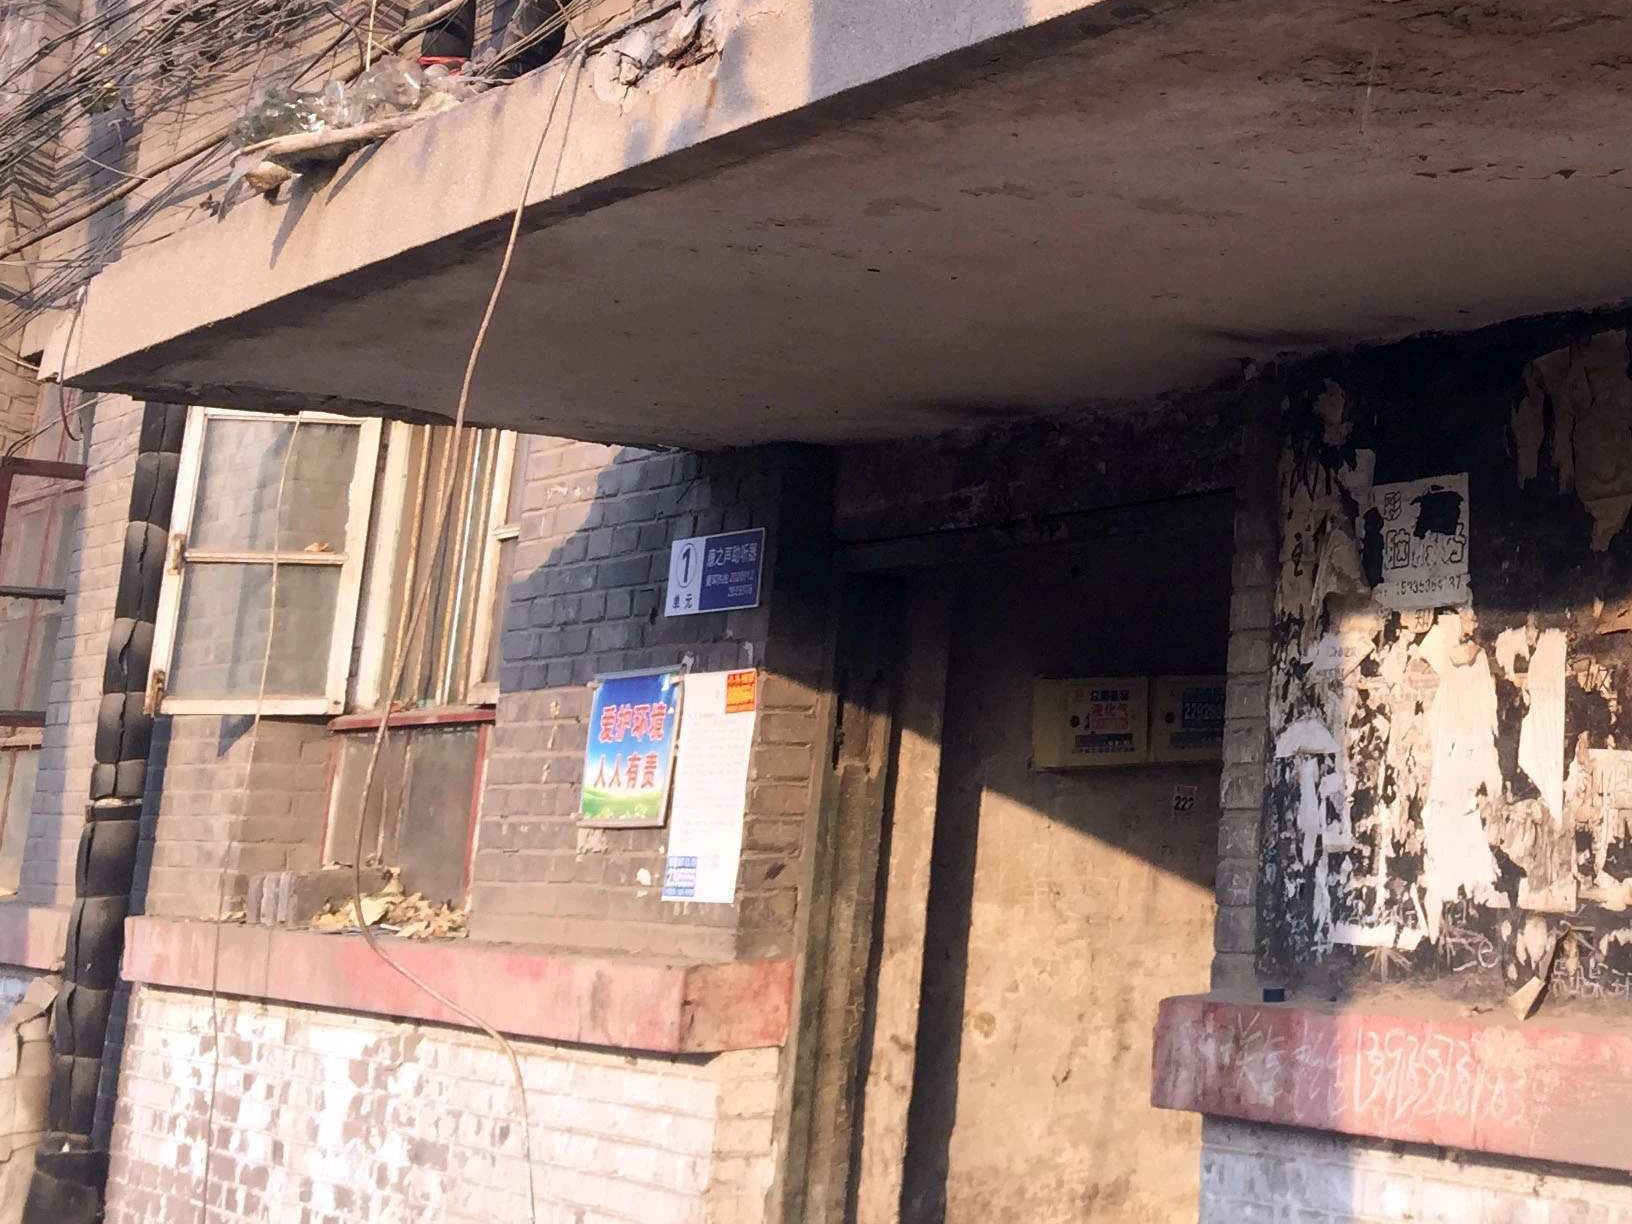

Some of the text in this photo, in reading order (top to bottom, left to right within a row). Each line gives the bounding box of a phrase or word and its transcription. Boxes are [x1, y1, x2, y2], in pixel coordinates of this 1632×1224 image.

[682, 547, 693, 584] 1
[600, 702, 667, 743] 爱护环境
[593, 752, 659, 789] 人人有责
